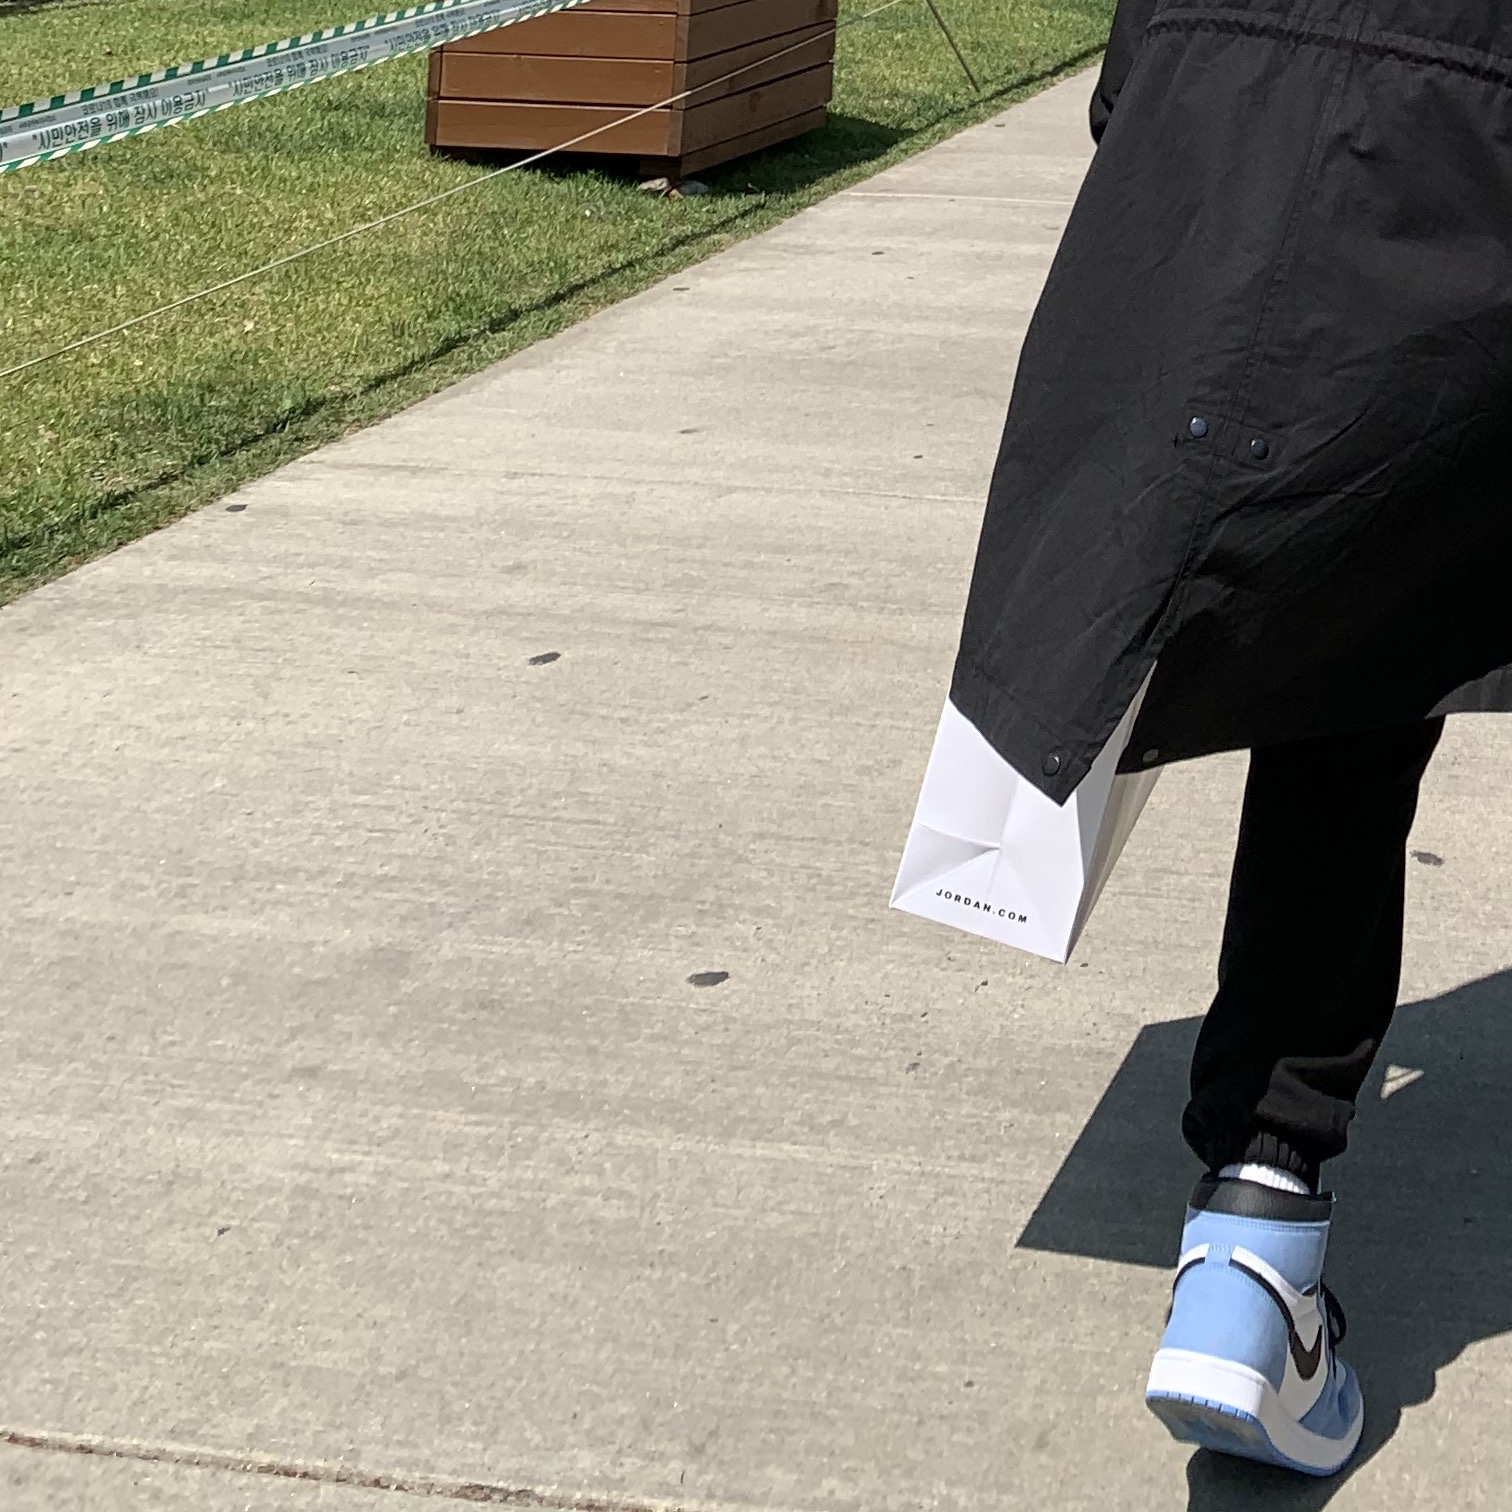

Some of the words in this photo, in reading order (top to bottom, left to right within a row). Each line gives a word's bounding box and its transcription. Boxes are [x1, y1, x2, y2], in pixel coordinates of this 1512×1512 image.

[105, 112, 130, 133] 위해
[134, 101, 157, 125] 잠시
[935, 888, 1029, 924] JORDAN.COM
